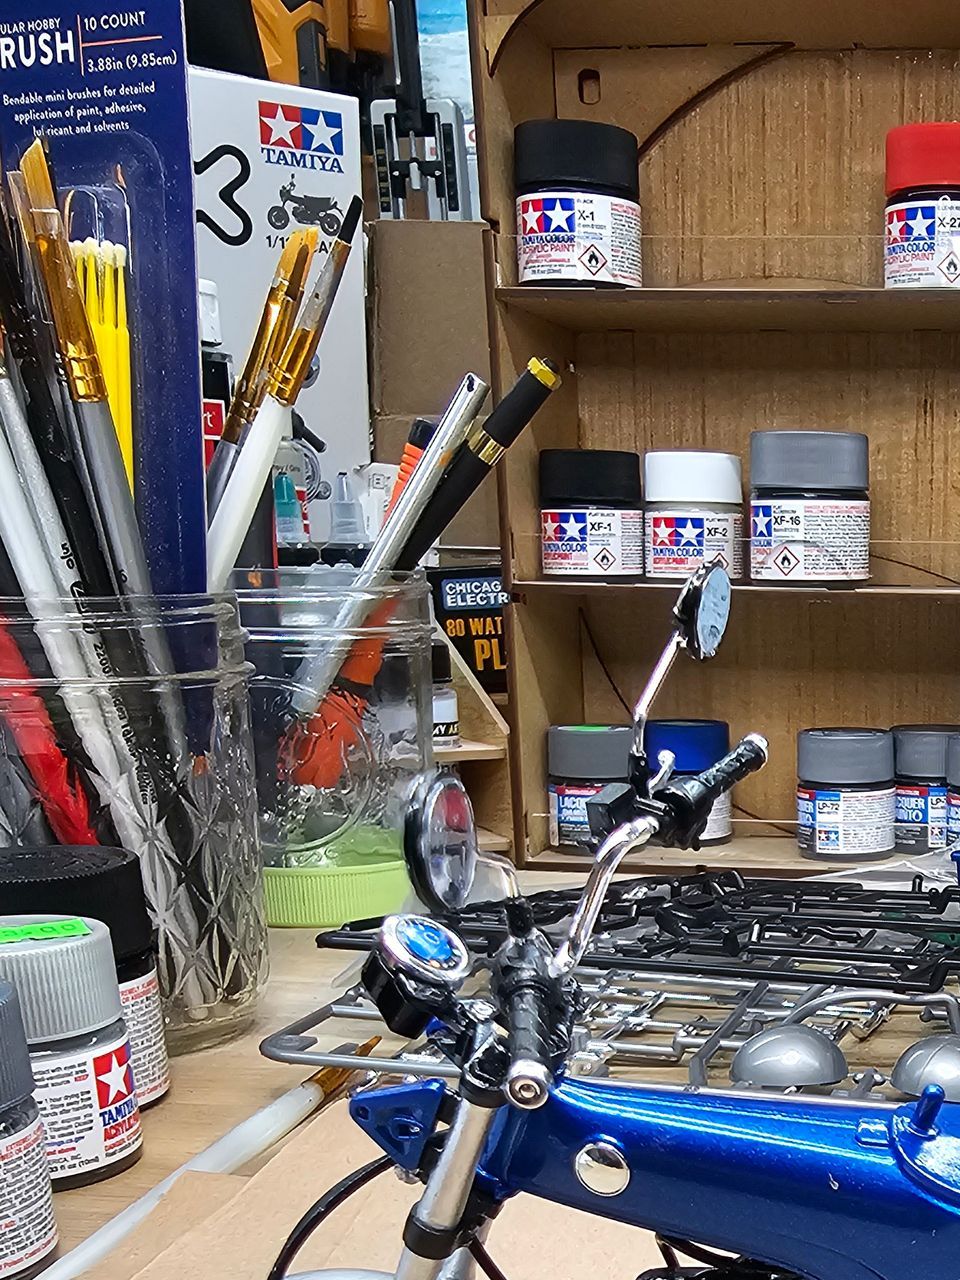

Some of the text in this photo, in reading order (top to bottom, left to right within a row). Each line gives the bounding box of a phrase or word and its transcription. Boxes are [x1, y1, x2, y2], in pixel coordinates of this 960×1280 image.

[27, 17, 61, 32] HOBBY
[83, 11, 146, 31] 10 COUNT
[0, 29, 75, 69] RUSH
[87, 49, 178, 73] 3.88in (9.85cm)
[3, 80, 156, 106] Bendable mini brushes for detailed
[14, 108, 63, 125] application
[64, 105, 75, 118] of
[76, 104, 103, 121] paint,
[75, 121, 92, 134] and
[94, 121, 130, 133] solvents
[261, 147, 345, 174] TAMIYA
[577, 209, 595, 222] X-1
[550, 243, 576, 253] PAINT
[906, 242, 936, 253] COLOR
[589, 521, 612, 532] XF-1
[772, 515, 801, 526] XF-16
[706, 527, 729, 538] XF-2
[560, 542, 588, 553] COLOR
[676, 547, 705, 558] COLOR
[445, 581, 502, 595] CHICAG
[447, 592, 511, 607] ELECTR
[446, 616, 503, 637] 80 WAT
[474, 639, 508, 671] PL
